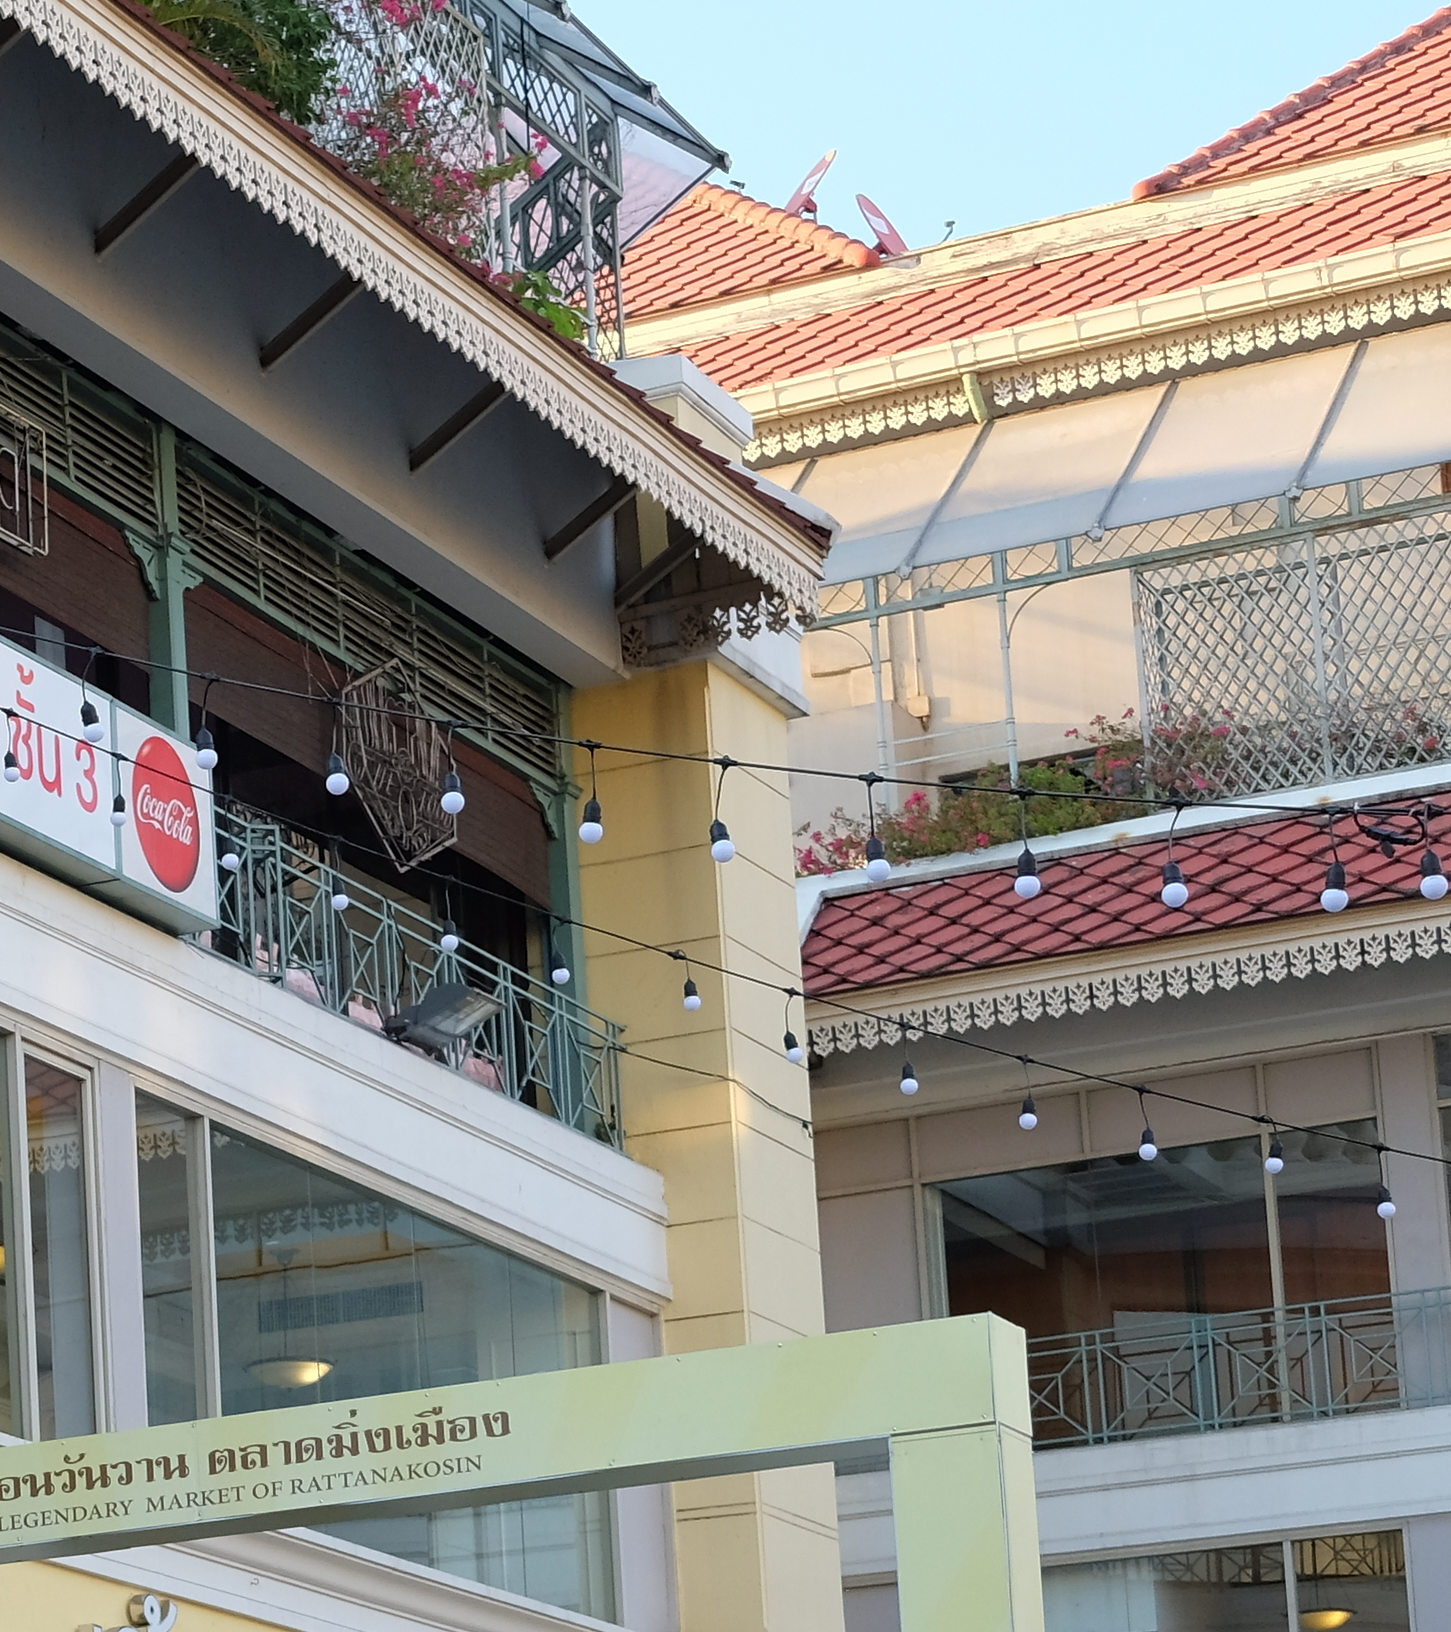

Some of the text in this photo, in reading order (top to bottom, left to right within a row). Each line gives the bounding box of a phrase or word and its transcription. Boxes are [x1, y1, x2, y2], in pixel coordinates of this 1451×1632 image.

[75, 737, 100, 813] 3
[136, 783, 195, 846] Coca-Cola
[208, 1406, 513, 1477] ตลาดมิ่งเมือง
[145, 1485, 246, 1514] MARKET
[252, 1480, 284, 1501] OF
[289, 1455, 484, 1495] RATTANAKOSIN
